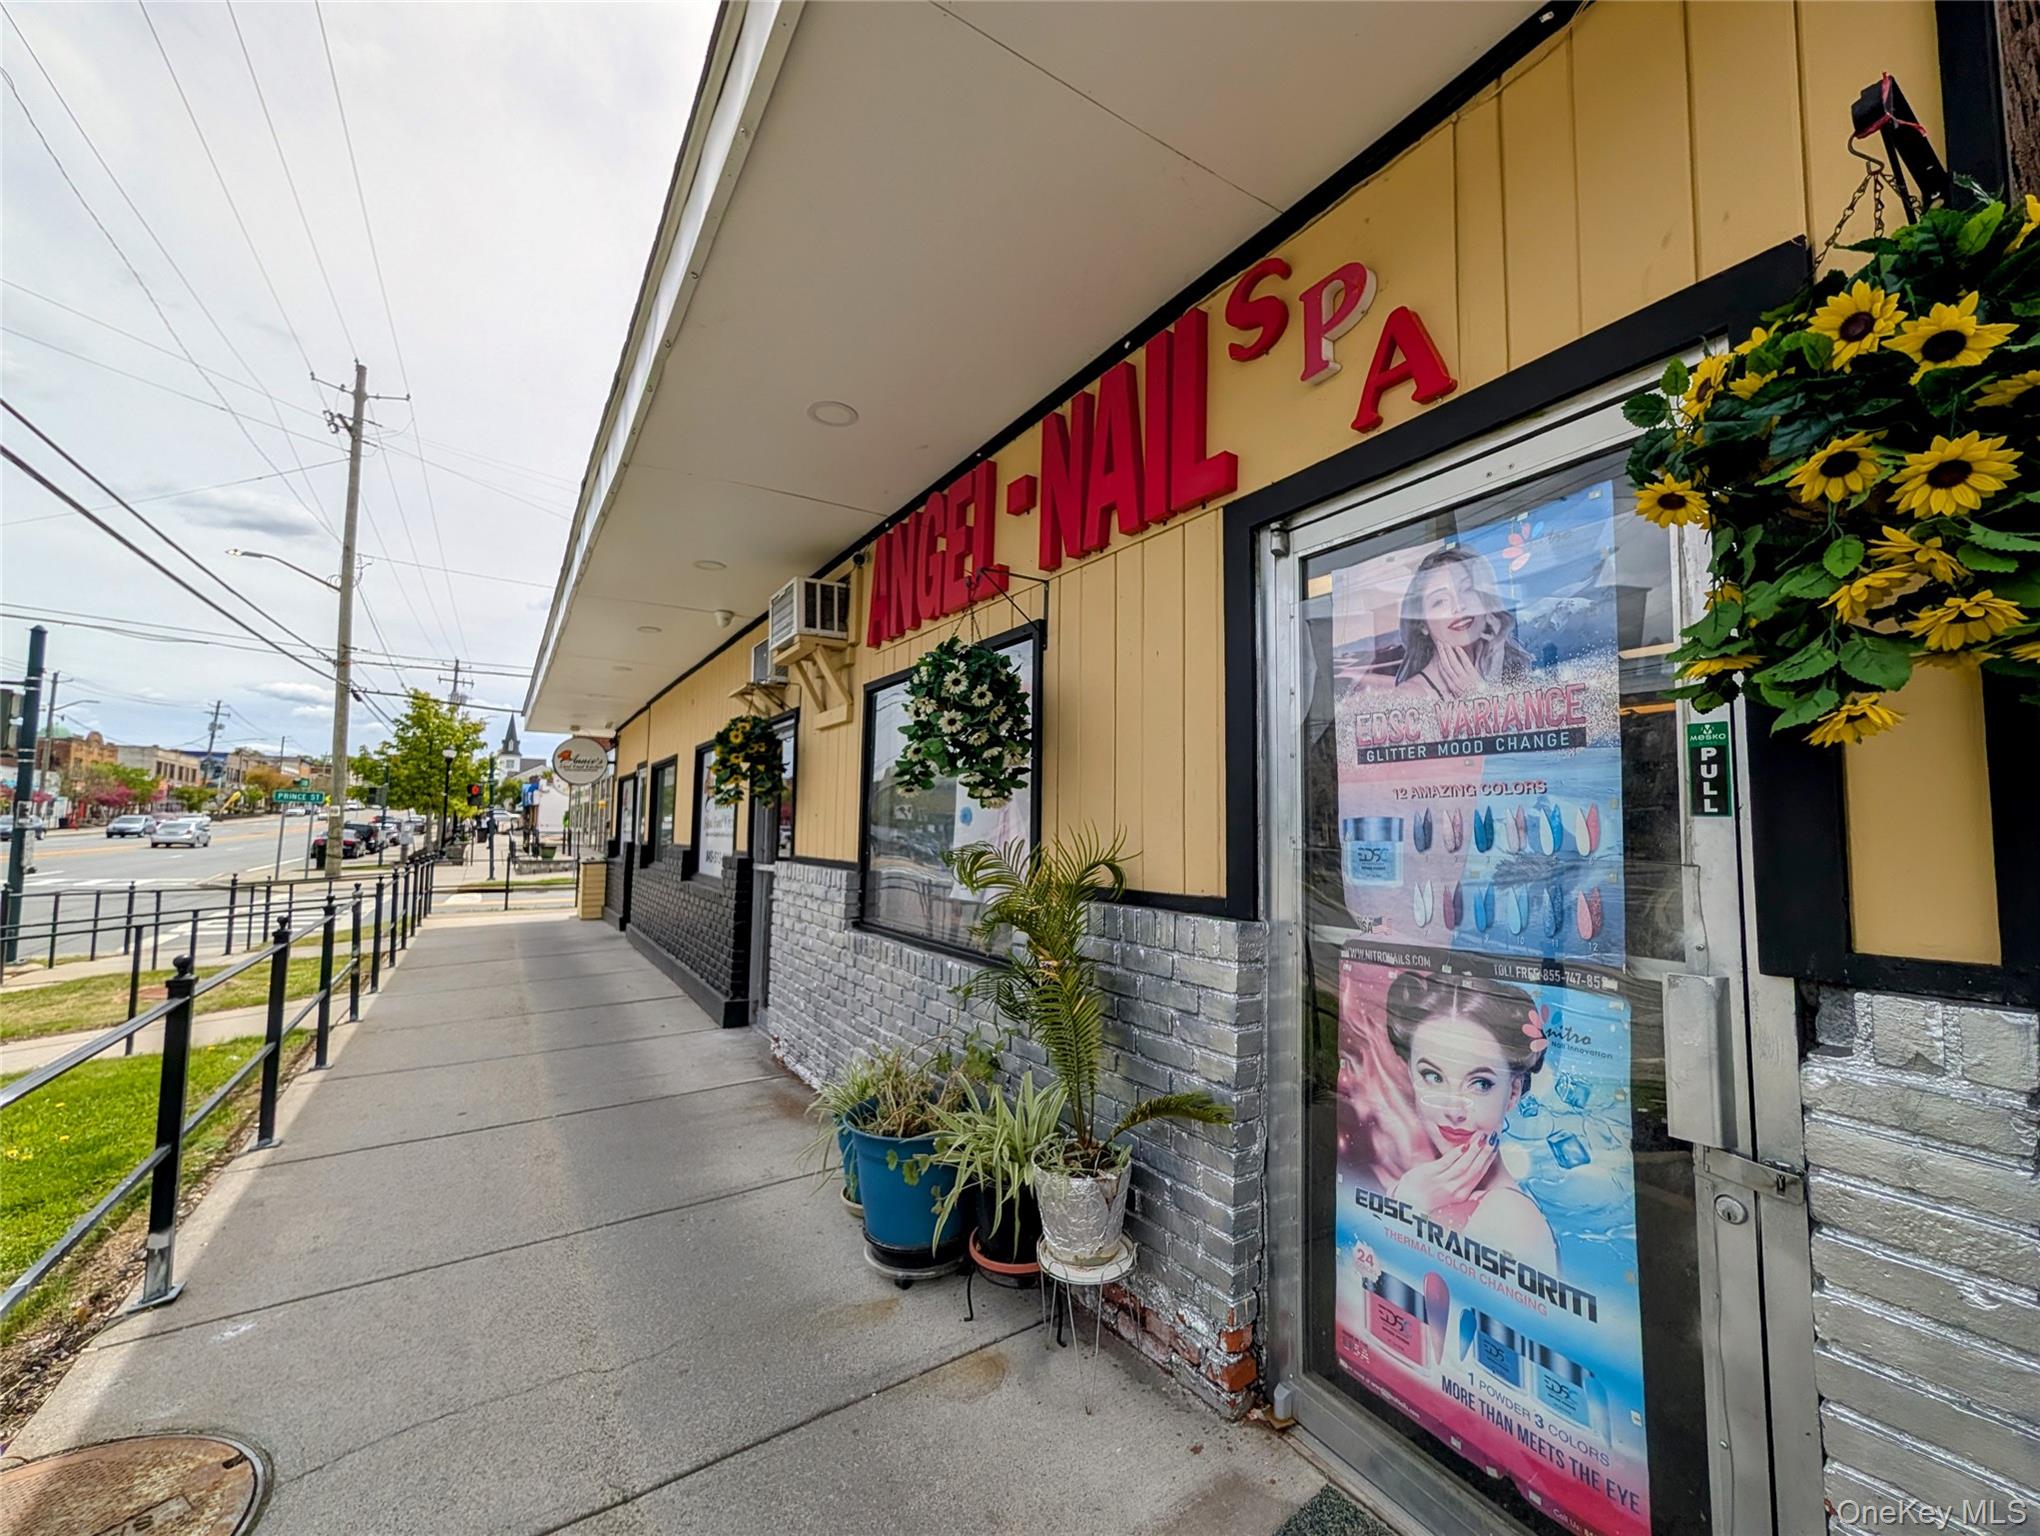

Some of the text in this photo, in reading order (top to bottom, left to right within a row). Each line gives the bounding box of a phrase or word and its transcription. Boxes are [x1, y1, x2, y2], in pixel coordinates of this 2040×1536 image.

[1225, 257, 1458, 434] SPA
[1356, 683, 1587, 746] EDSC VARIANCE
[1367, 732, 1570, 763] GLITTER MOOD CHANGE
[1393, 780, 1548, 800] 12 AMAZING COLORS
[1700, 747, 1718, 812] PULL
[277, 791, 320, 801] PRINCE ST
[1589, 942, 1599, 951] 12
[1543, 1026, 1592, 1045] nitro
[1552, 1041, 1613, 1060] Nail Innovation
[1357, 1248, 1374, 1267] 24
[1384, 1227, 1548, 1316] THERMAL COLOR CHANGING
[1468, 1372, 1475, 1387] 1
[1479, 1380, 1531, 1419] POWDER
[1534, 1413, 1545, 1429] 3
[1548, 1424, 1611, 1467] COLORS
[1441, 1375, 1476, 1412] MORE
[1478, 1399, 1514, 1436] THAN
[1517, 1423, 1566, 1470] MEETS
[1569, 1456, 1601, 1492] THE
[1606, 1478, 1641, 1515] EYE
